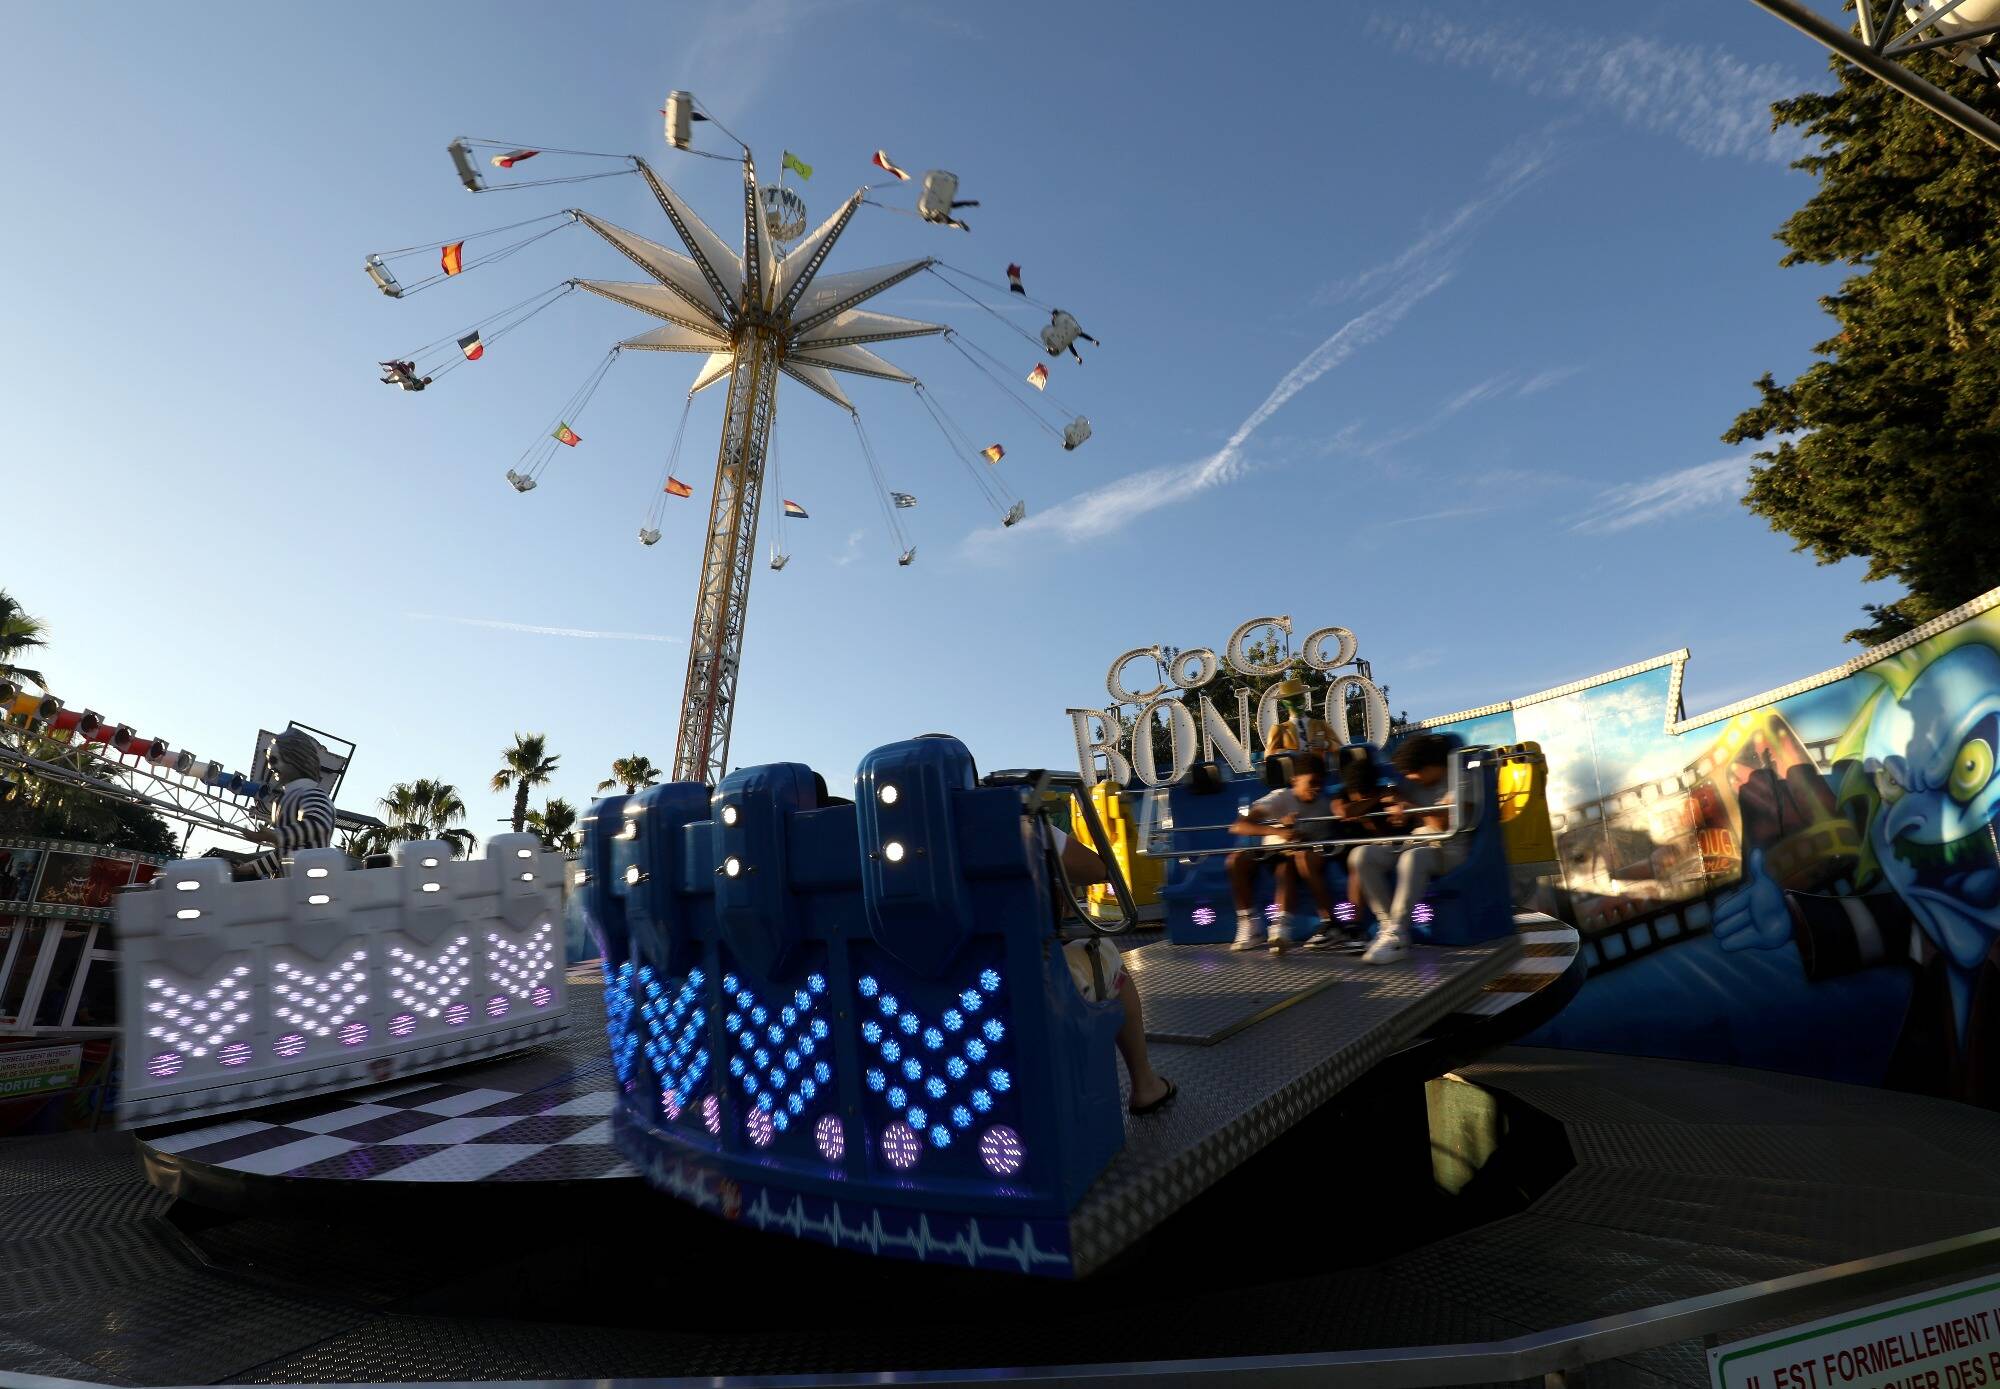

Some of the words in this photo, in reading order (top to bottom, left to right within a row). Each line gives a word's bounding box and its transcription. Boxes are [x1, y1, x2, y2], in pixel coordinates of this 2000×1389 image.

[1773, 1360, 1816, 1389] EST
[1823, 1311, 1990, 1386] FORMELLEMENT
[1944, 1357, 1987, 1389] DES
